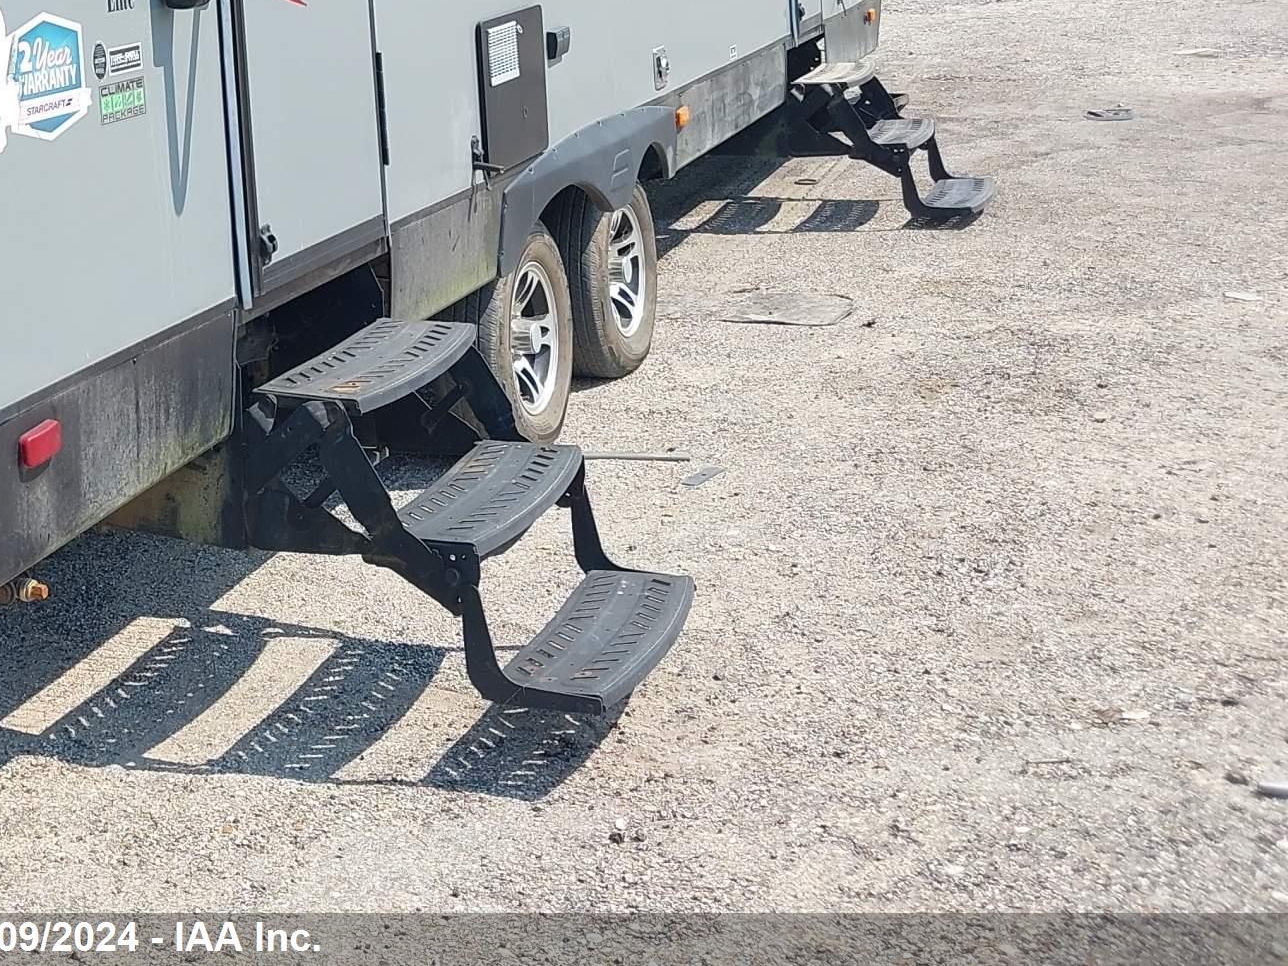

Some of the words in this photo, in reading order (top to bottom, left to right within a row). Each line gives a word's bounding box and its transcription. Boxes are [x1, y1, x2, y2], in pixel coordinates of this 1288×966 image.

[18, 40, 33, 74] 2
[33, 37, 73, 72] Year
[101, 78, 143, 97] CLIMATE
[27, 99, 66, 116] STARCRAFT
[102, 104, 145, 123] PACKAGE
